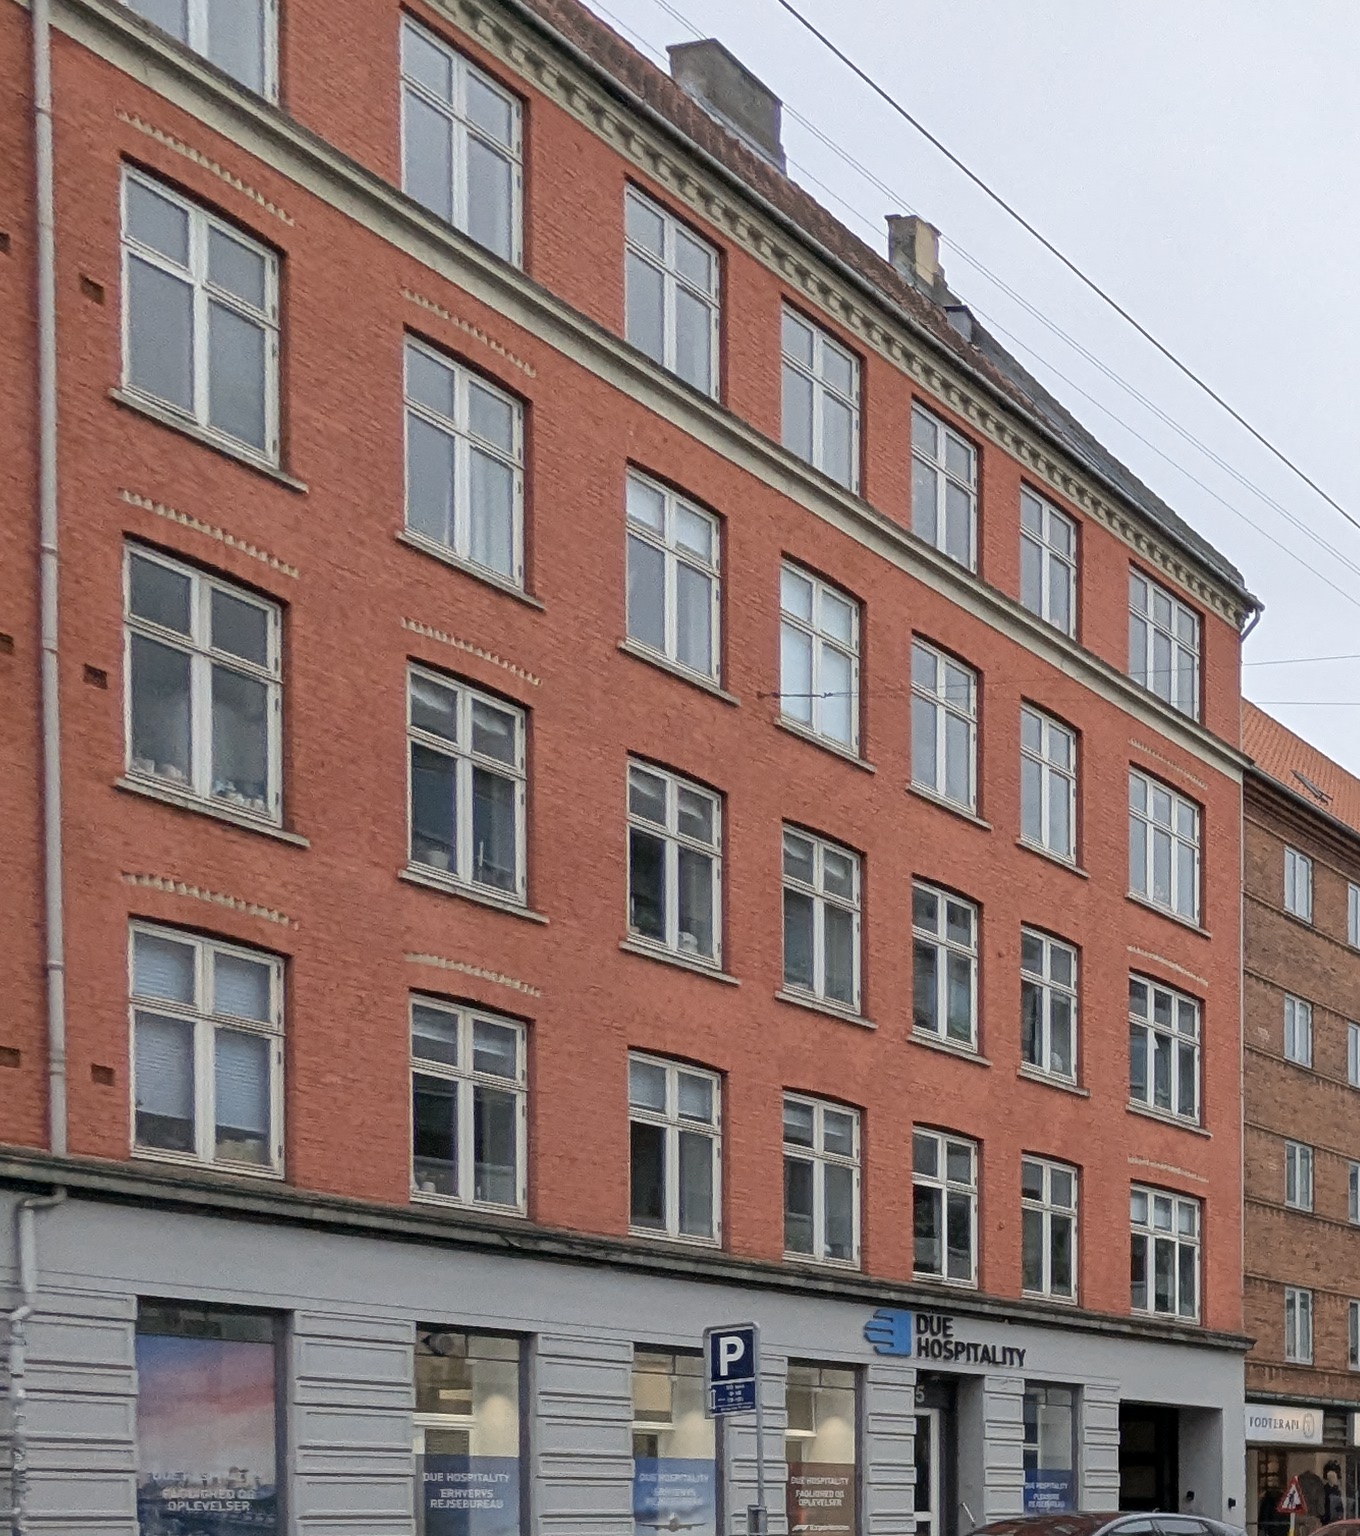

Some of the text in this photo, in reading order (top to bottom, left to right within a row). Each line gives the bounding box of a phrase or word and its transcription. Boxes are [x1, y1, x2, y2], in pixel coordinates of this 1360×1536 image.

[916, 1313, 954, 1338] DUE
[720, 1336, 745, 1376] P
[916, 1337, 1027, 1367] HOSPITALITY
[423, 1472, 510, 1483] DUE HOSPITALITY
[167, 1500, 251, 1512] OPLEVELSER
[430, 1499, 504, 1509] REJSEBUREAU
